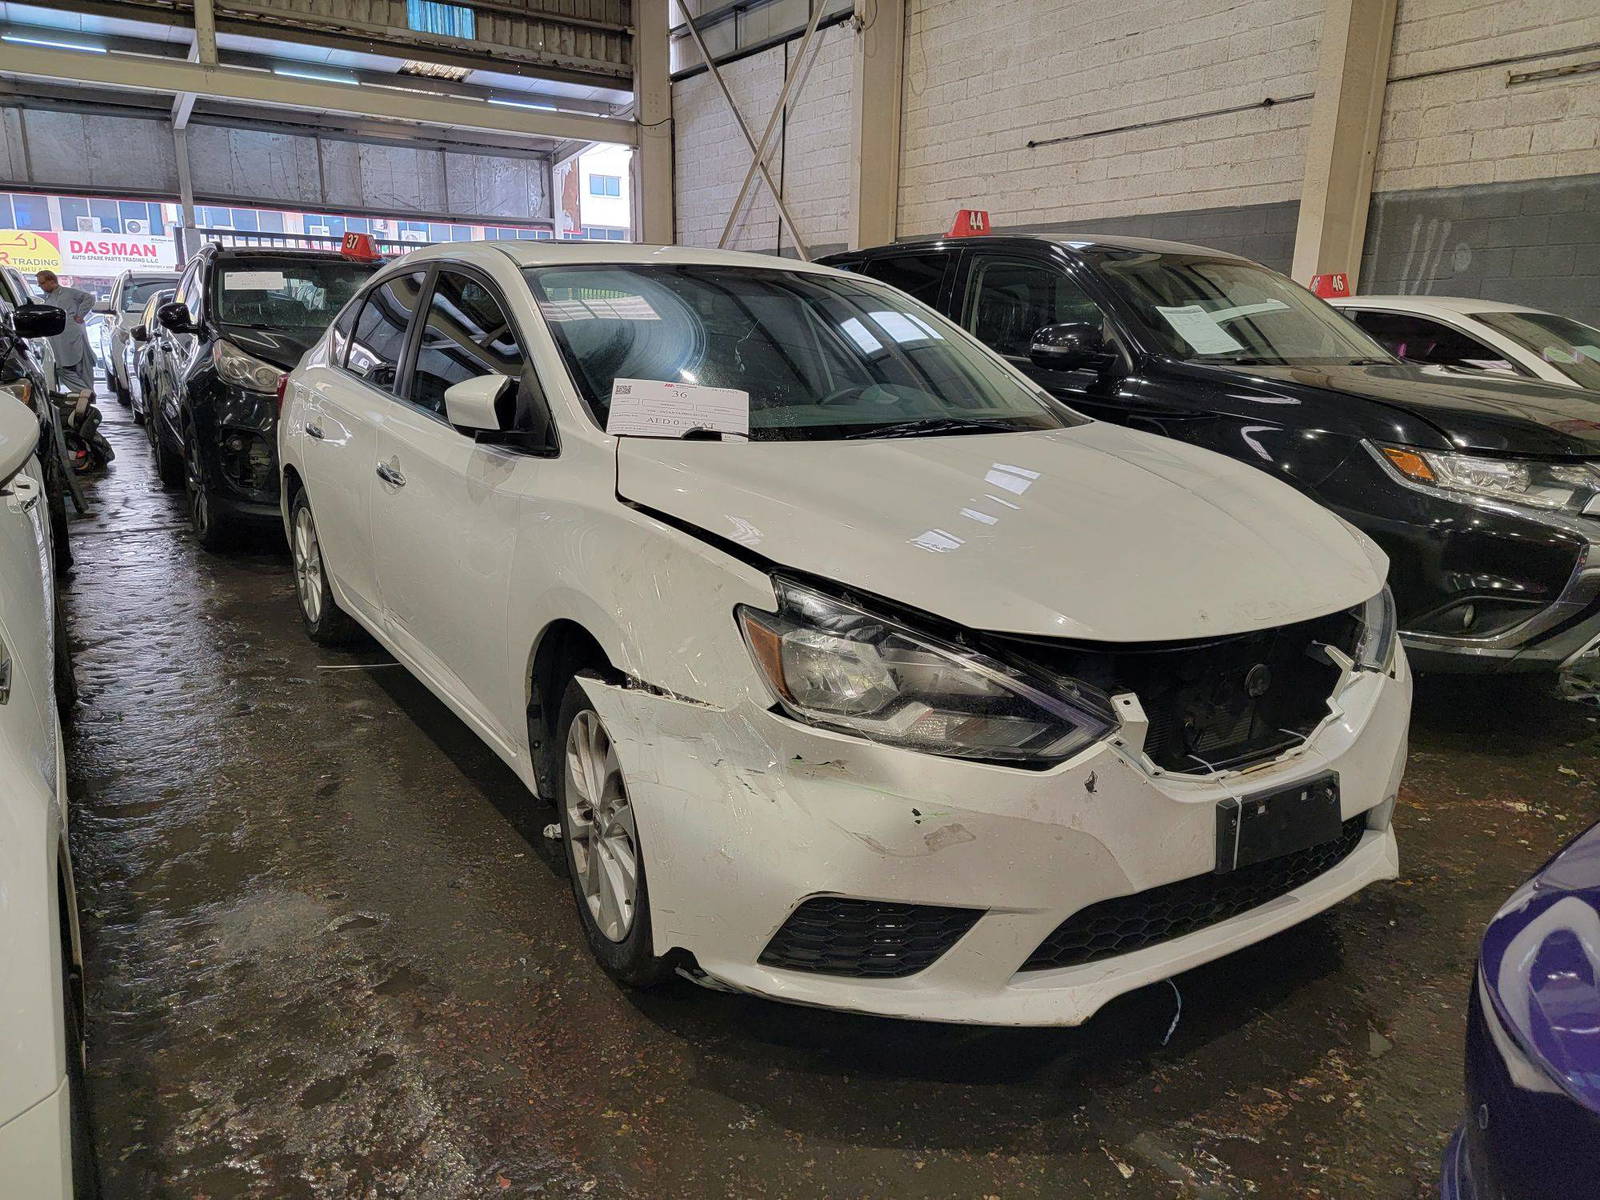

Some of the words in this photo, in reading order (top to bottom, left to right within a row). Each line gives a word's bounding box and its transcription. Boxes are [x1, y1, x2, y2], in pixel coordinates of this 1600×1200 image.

[970, 211, 983, 230] 44
[70, 240, 157, 257] DASMAN
[346, 233, 359, 249] 37
[11, 257, 59, 266] TRADING
[1332, 274, 1344, 292] 46
[672, 390, 688, 400] 36
